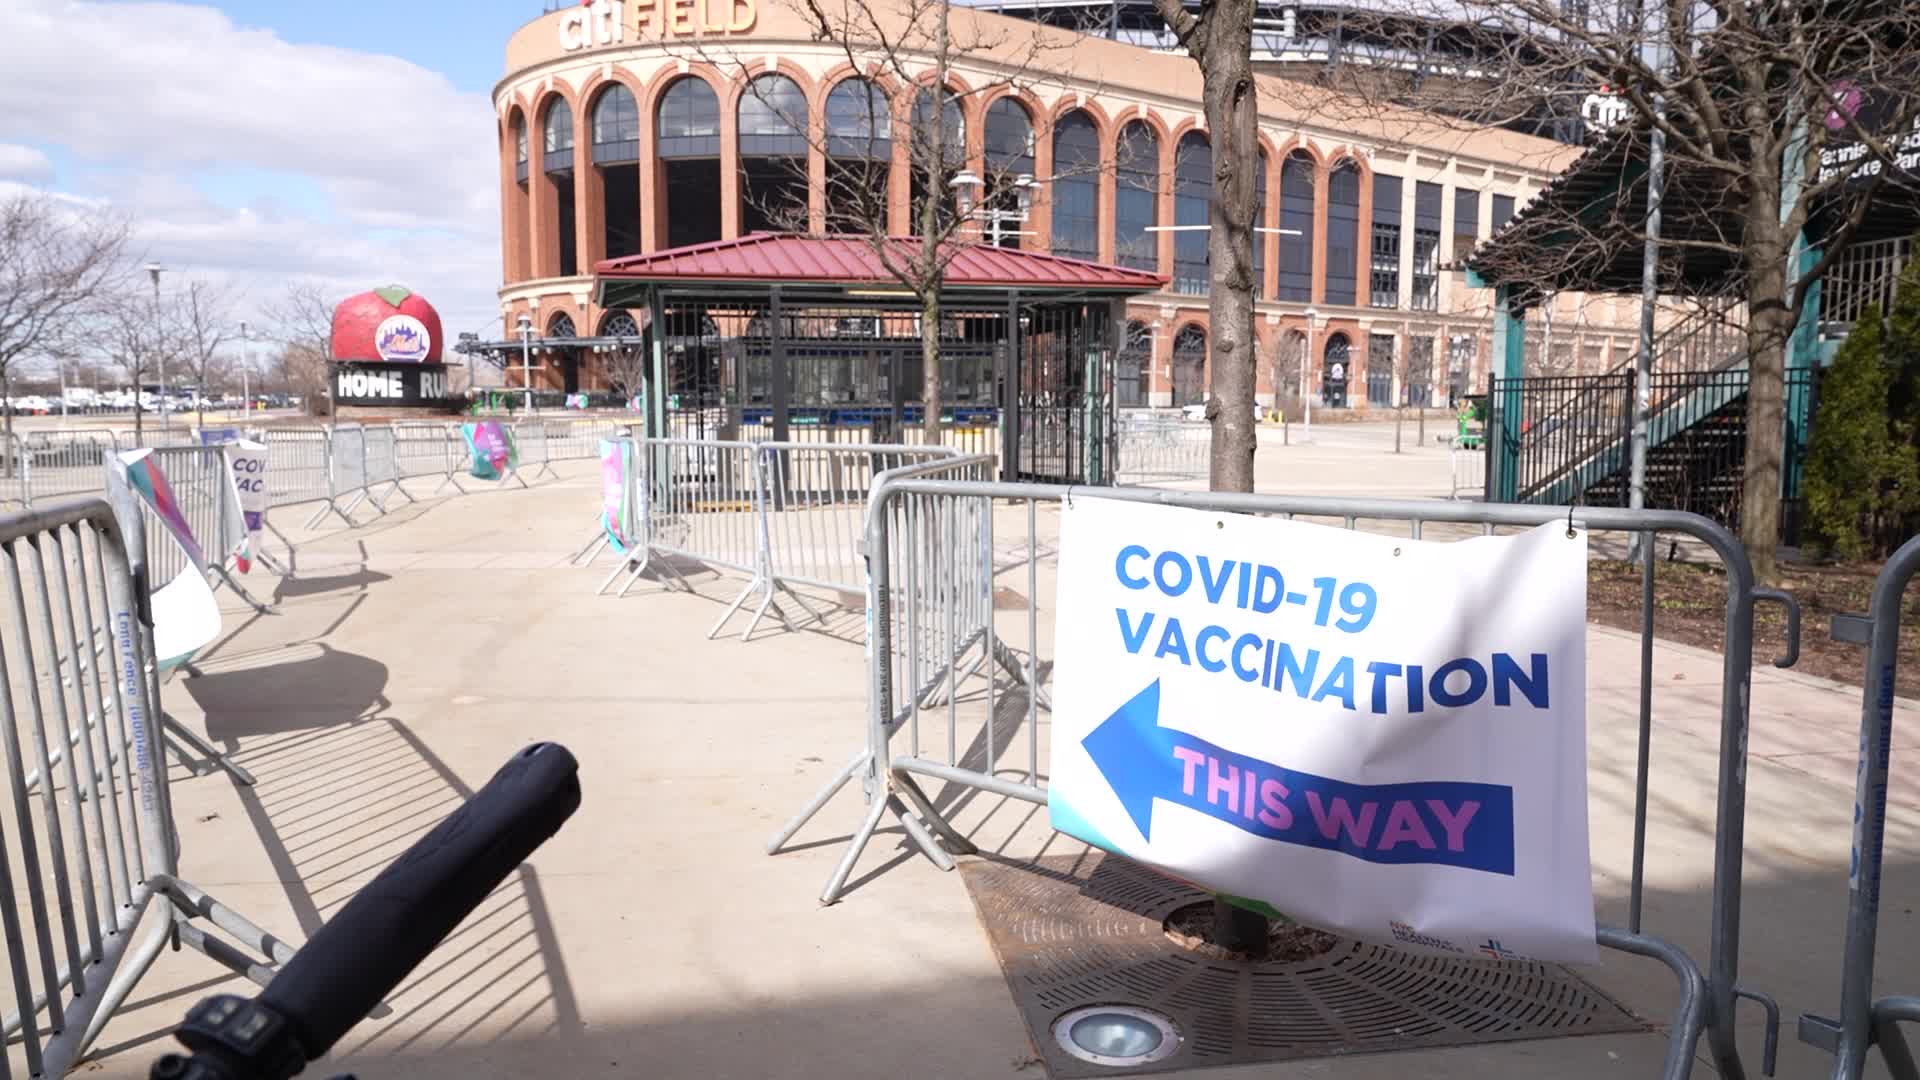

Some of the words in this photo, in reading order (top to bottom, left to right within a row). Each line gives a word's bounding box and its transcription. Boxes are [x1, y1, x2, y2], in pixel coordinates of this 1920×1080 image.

[635, 0, 758, 40] FIELD
[338, 371, 403, 398] HOME
[1115, 544, 1377, 634] COVID-19
[1115, 607, 1550, 715] VACCINATION
[1173, 745, 1294, 830] THIS
[1304, 790, 1481, 853] WAY
